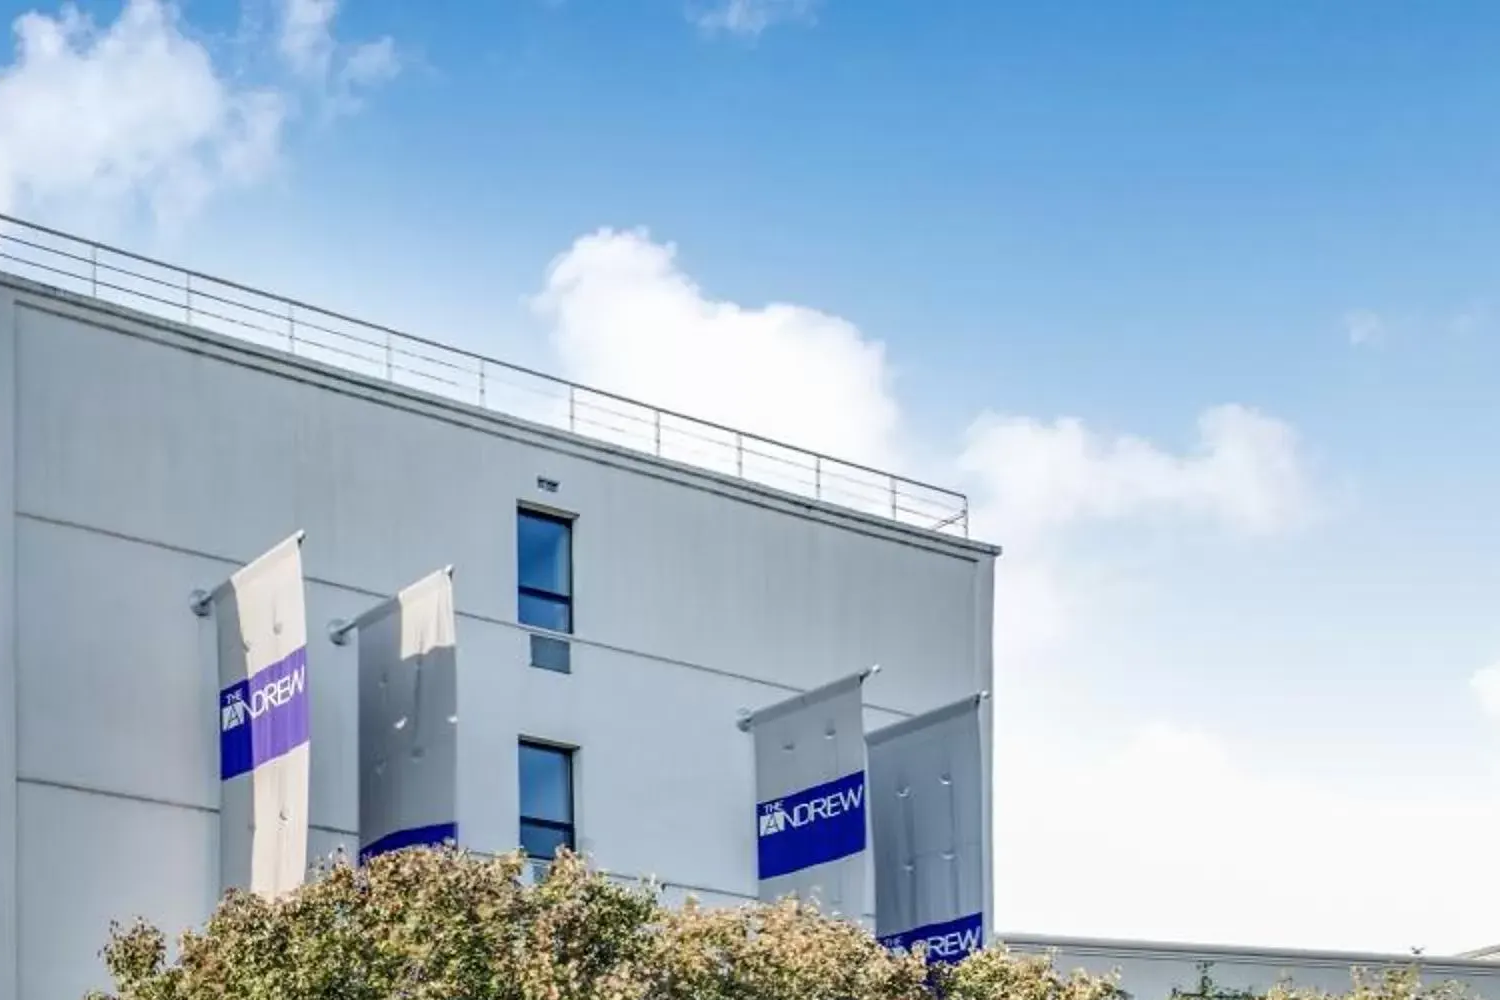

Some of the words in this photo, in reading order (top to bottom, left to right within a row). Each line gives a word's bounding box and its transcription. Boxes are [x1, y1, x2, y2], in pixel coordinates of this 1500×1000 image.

[222, 664, 305, 732] ANDREW
[226, 687, 243, 704] THE
[759, 783, 863, 837] ANDREW
[764, 800, 784, 815] THE
